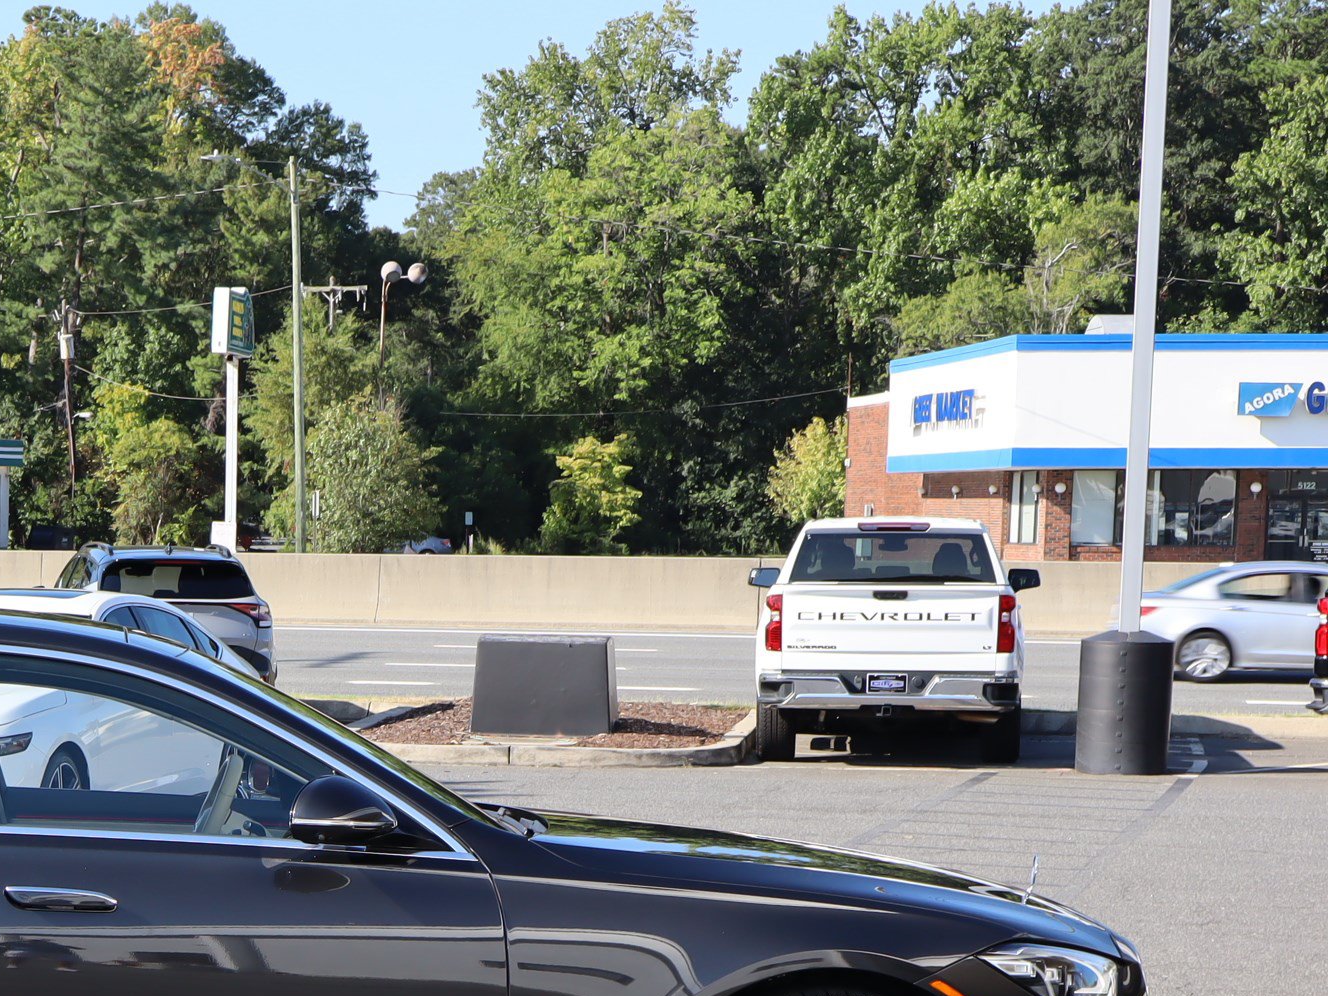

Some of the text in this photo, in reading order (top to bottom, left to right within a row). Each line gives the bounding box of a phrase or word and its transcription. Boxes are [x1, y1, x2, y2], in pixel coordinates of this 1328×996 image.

[936, 388, 975, 422] MARKET
[1244, 384, 1295, 415] AGORA
[1298, 481, 1316, 490] 5122
[797, 611, 982, 621] CHEVROLET
